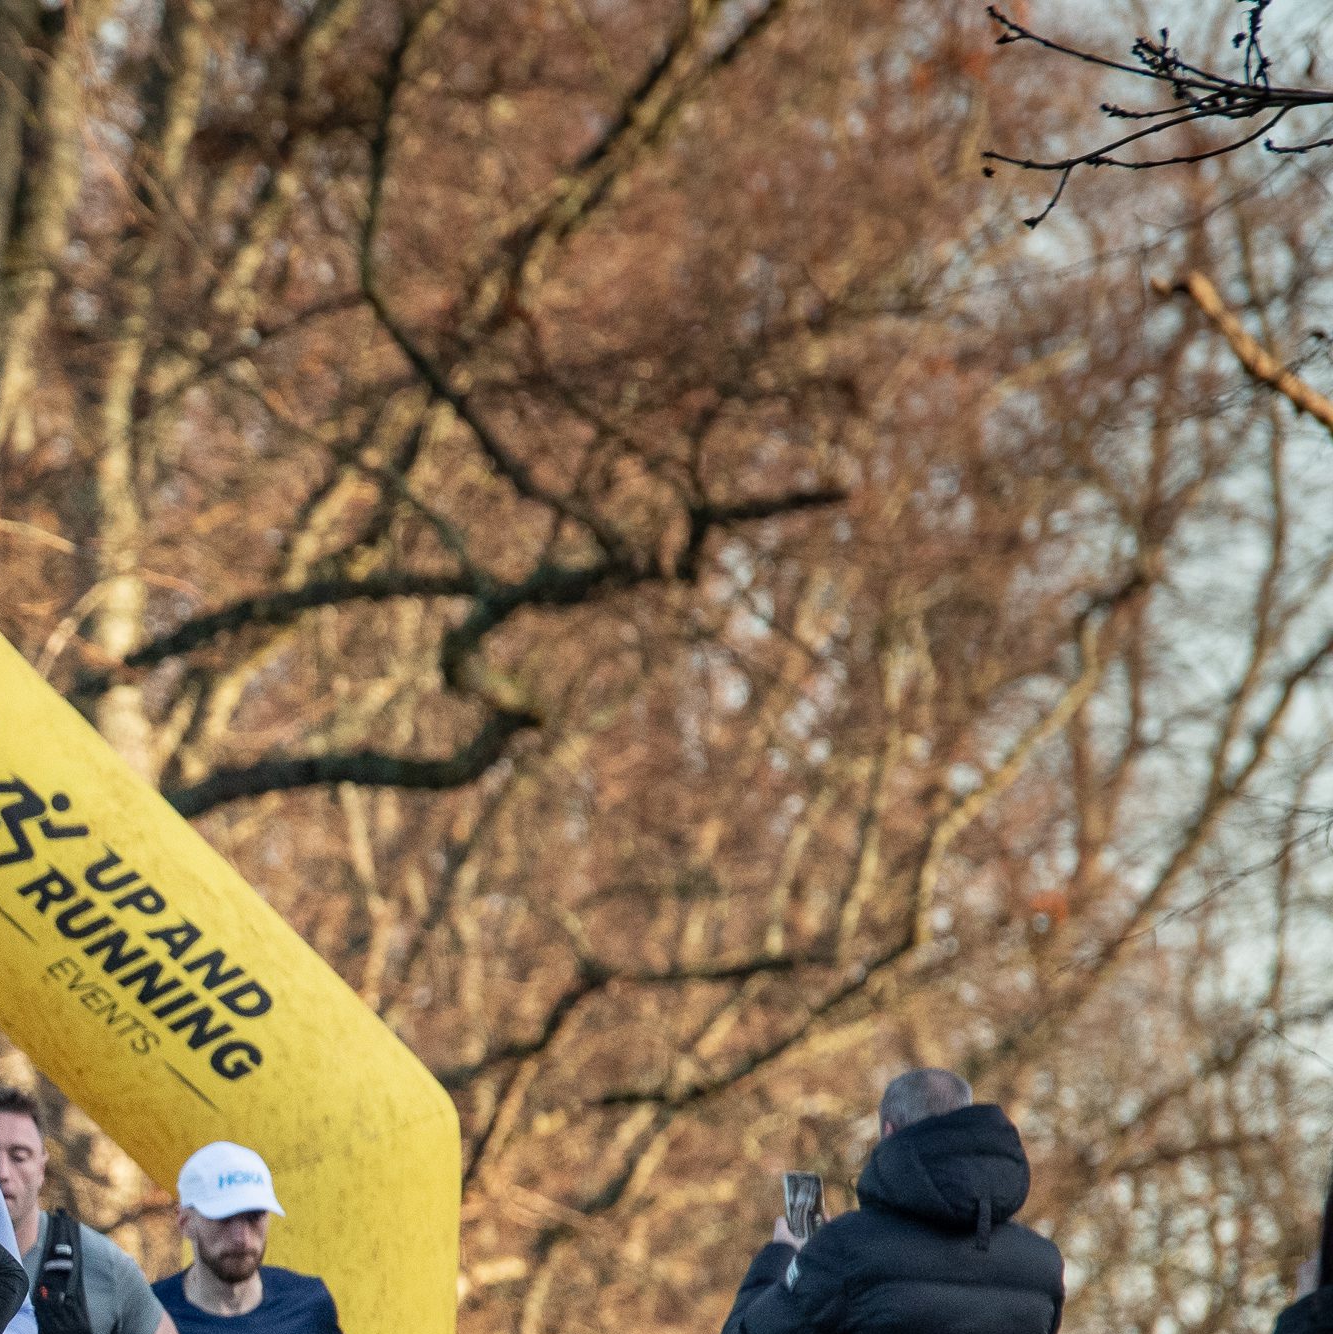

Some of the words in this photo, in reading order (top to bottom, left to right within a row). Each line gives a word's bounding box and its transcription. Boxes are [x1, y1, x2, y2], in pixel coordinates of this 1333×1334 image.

[17, 864, 264, 1081] RUNNING
[44, 956, 161, 1056] EVENTS
[85, 844, 167, 915] UP
[144, 915, 273, 1018] AND
